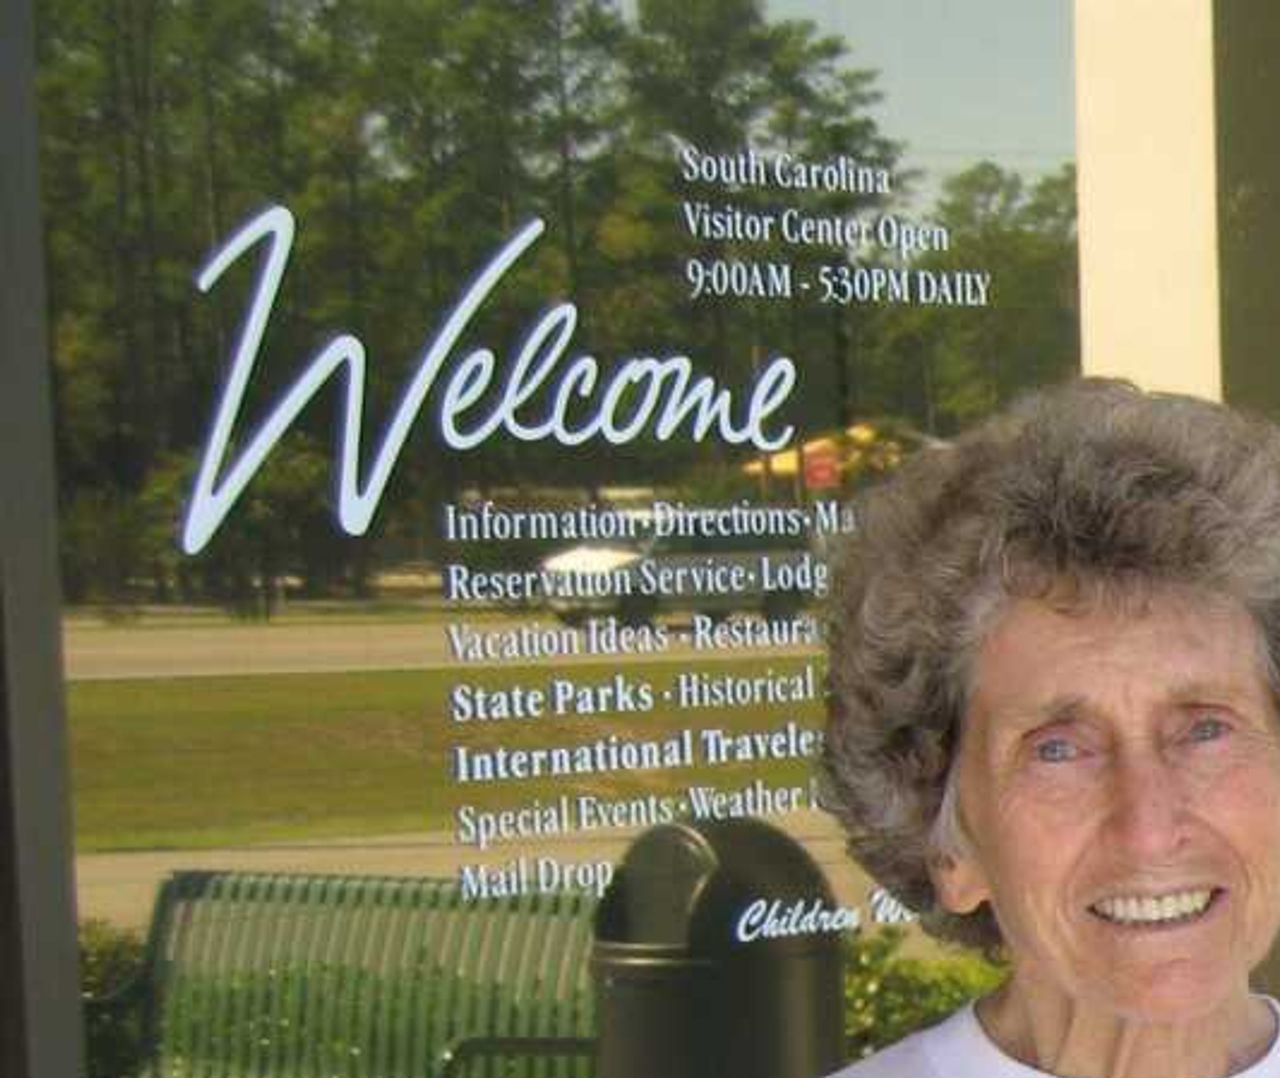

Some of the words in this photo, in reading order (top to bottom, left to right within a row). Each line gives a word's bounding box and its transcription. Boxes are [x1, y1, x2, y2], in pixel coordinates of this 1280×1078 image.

[684, 148, 765, 185] South
[774, 153, 891, 194] Carolina
[684, 204, 774, 241] Visitor
[781, 209, 870, 246] Center
[878, 214, 949, 258] Open
[687, 258, 792, 299] 9:00AM
[917, 269, 991, 306] DAILY
[182, 204, 797, 555] Welcome
[447, 564, 632, 600] Reservation
[448, 622, 580, 661] Vacation
[589, 615, 669, 655] Ideas
[452, 684, 544, 722] State
[554, 674, 654, 715] Parks
[679, 665, 815, 708] Historical
[456, 728, 693, 782] International
[457, 796, 569, 850] Special
[578, 795, 675, 831] Events
[689, 778, 804, 822] Weather
[460, 856, 528, 900] Mail
[537, 856, 614, 898] Drop
[736, 898, 860, 943] Children
